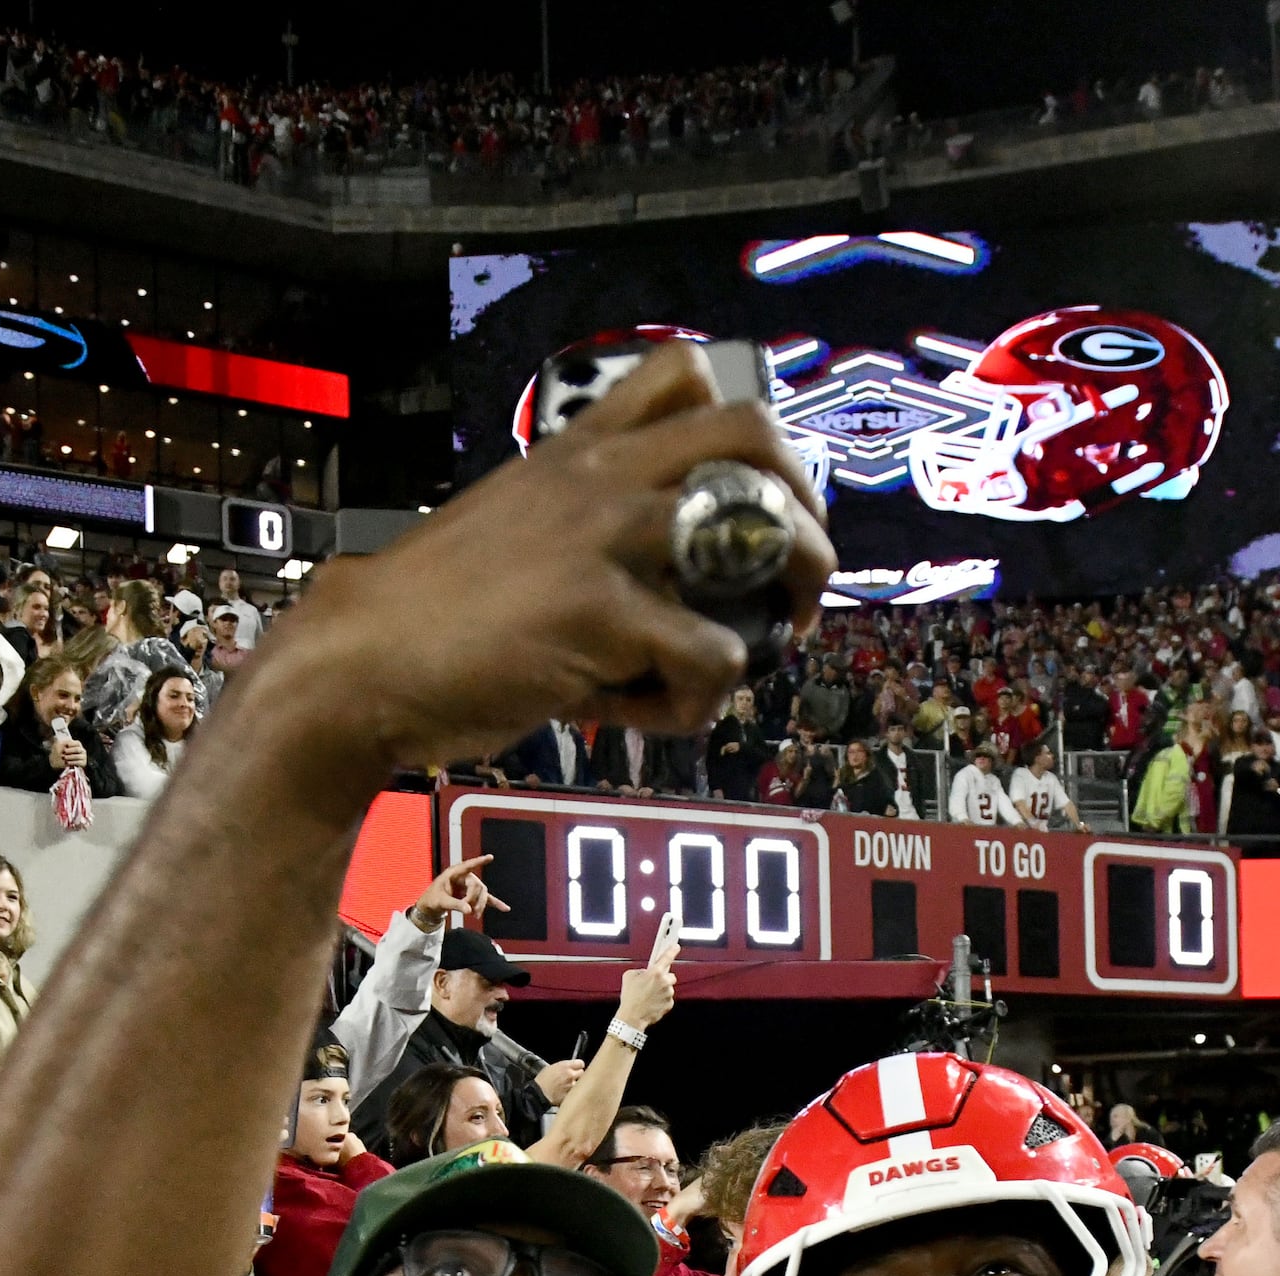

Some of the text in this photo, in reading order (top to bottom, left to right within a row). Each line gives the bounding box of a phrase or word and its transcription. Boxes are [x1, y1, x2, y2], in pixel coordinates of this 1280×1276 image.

[817, 409, 929, 432] versus
[258, 510, 283, 551] 0
[978, 793, 993, 820] 2
[1030, 791, 1049, 820] 12
[854, 830, 932, 871] DOWN
[974, 838, 1046, 880] TO GO
[567, 825, 800, 944] 0:00
[1167, 868, 1214, 966] 0
[868, 1156, 960, 1187] DAWGS
